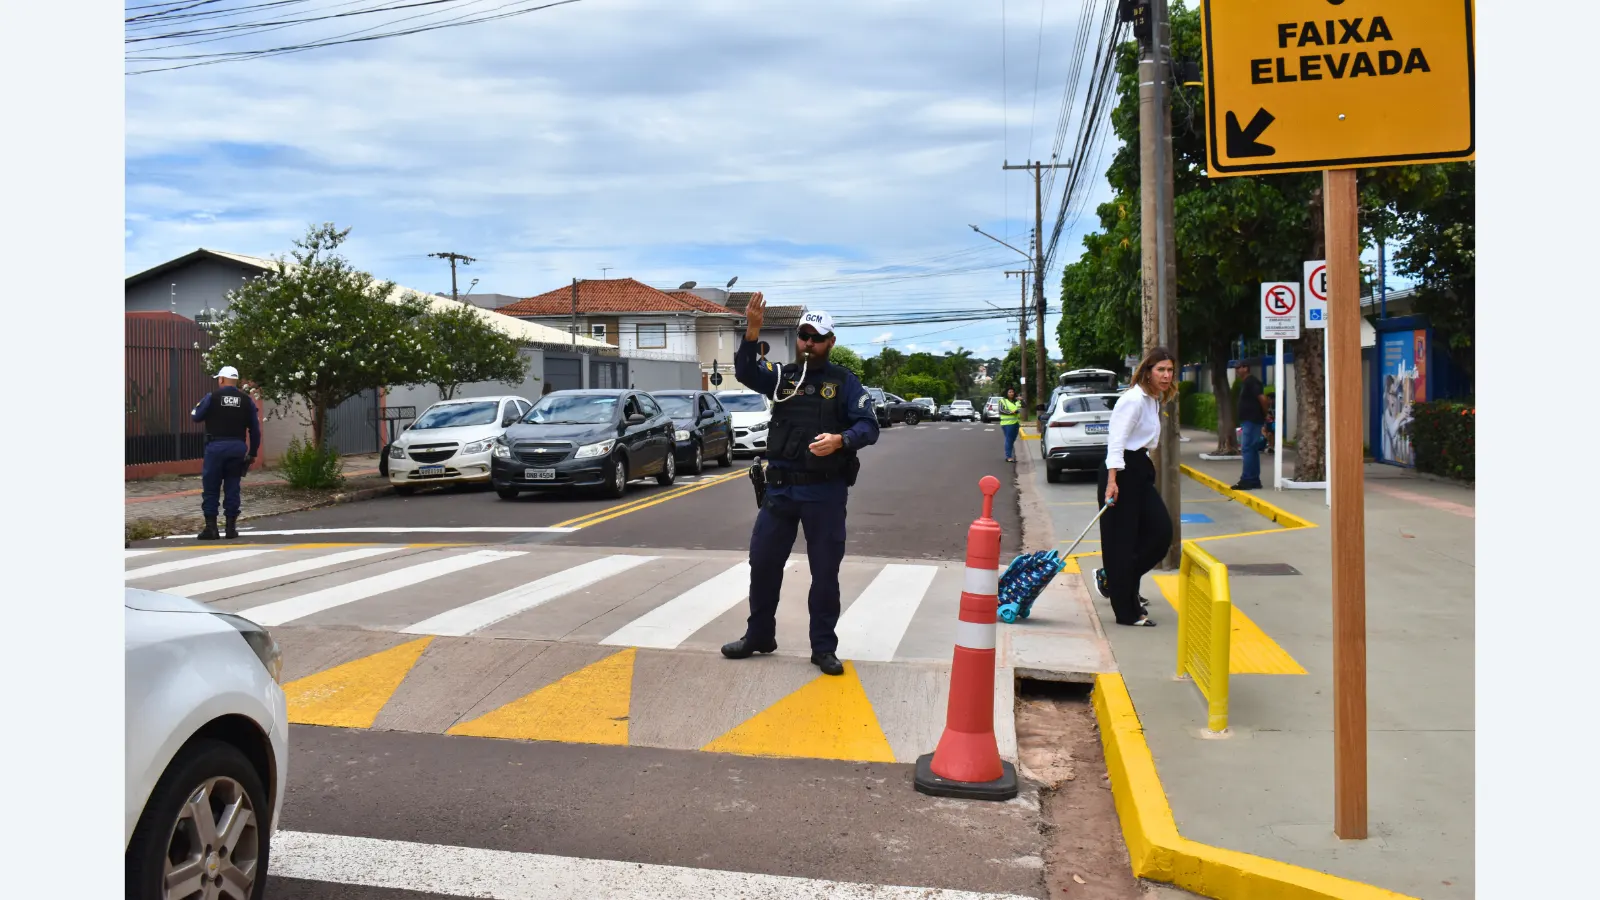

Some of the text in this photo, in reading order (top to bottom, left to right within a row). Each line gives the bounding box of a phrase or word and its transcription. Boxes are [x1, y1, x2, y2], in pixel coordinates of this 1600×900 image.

[1277, 16, 1393, 49] FAIXA
[1250, 47, 1431, 85] ELEVADA
[805, 314, 823, 324] GCM
[223, 396, 239, 405] GCM
